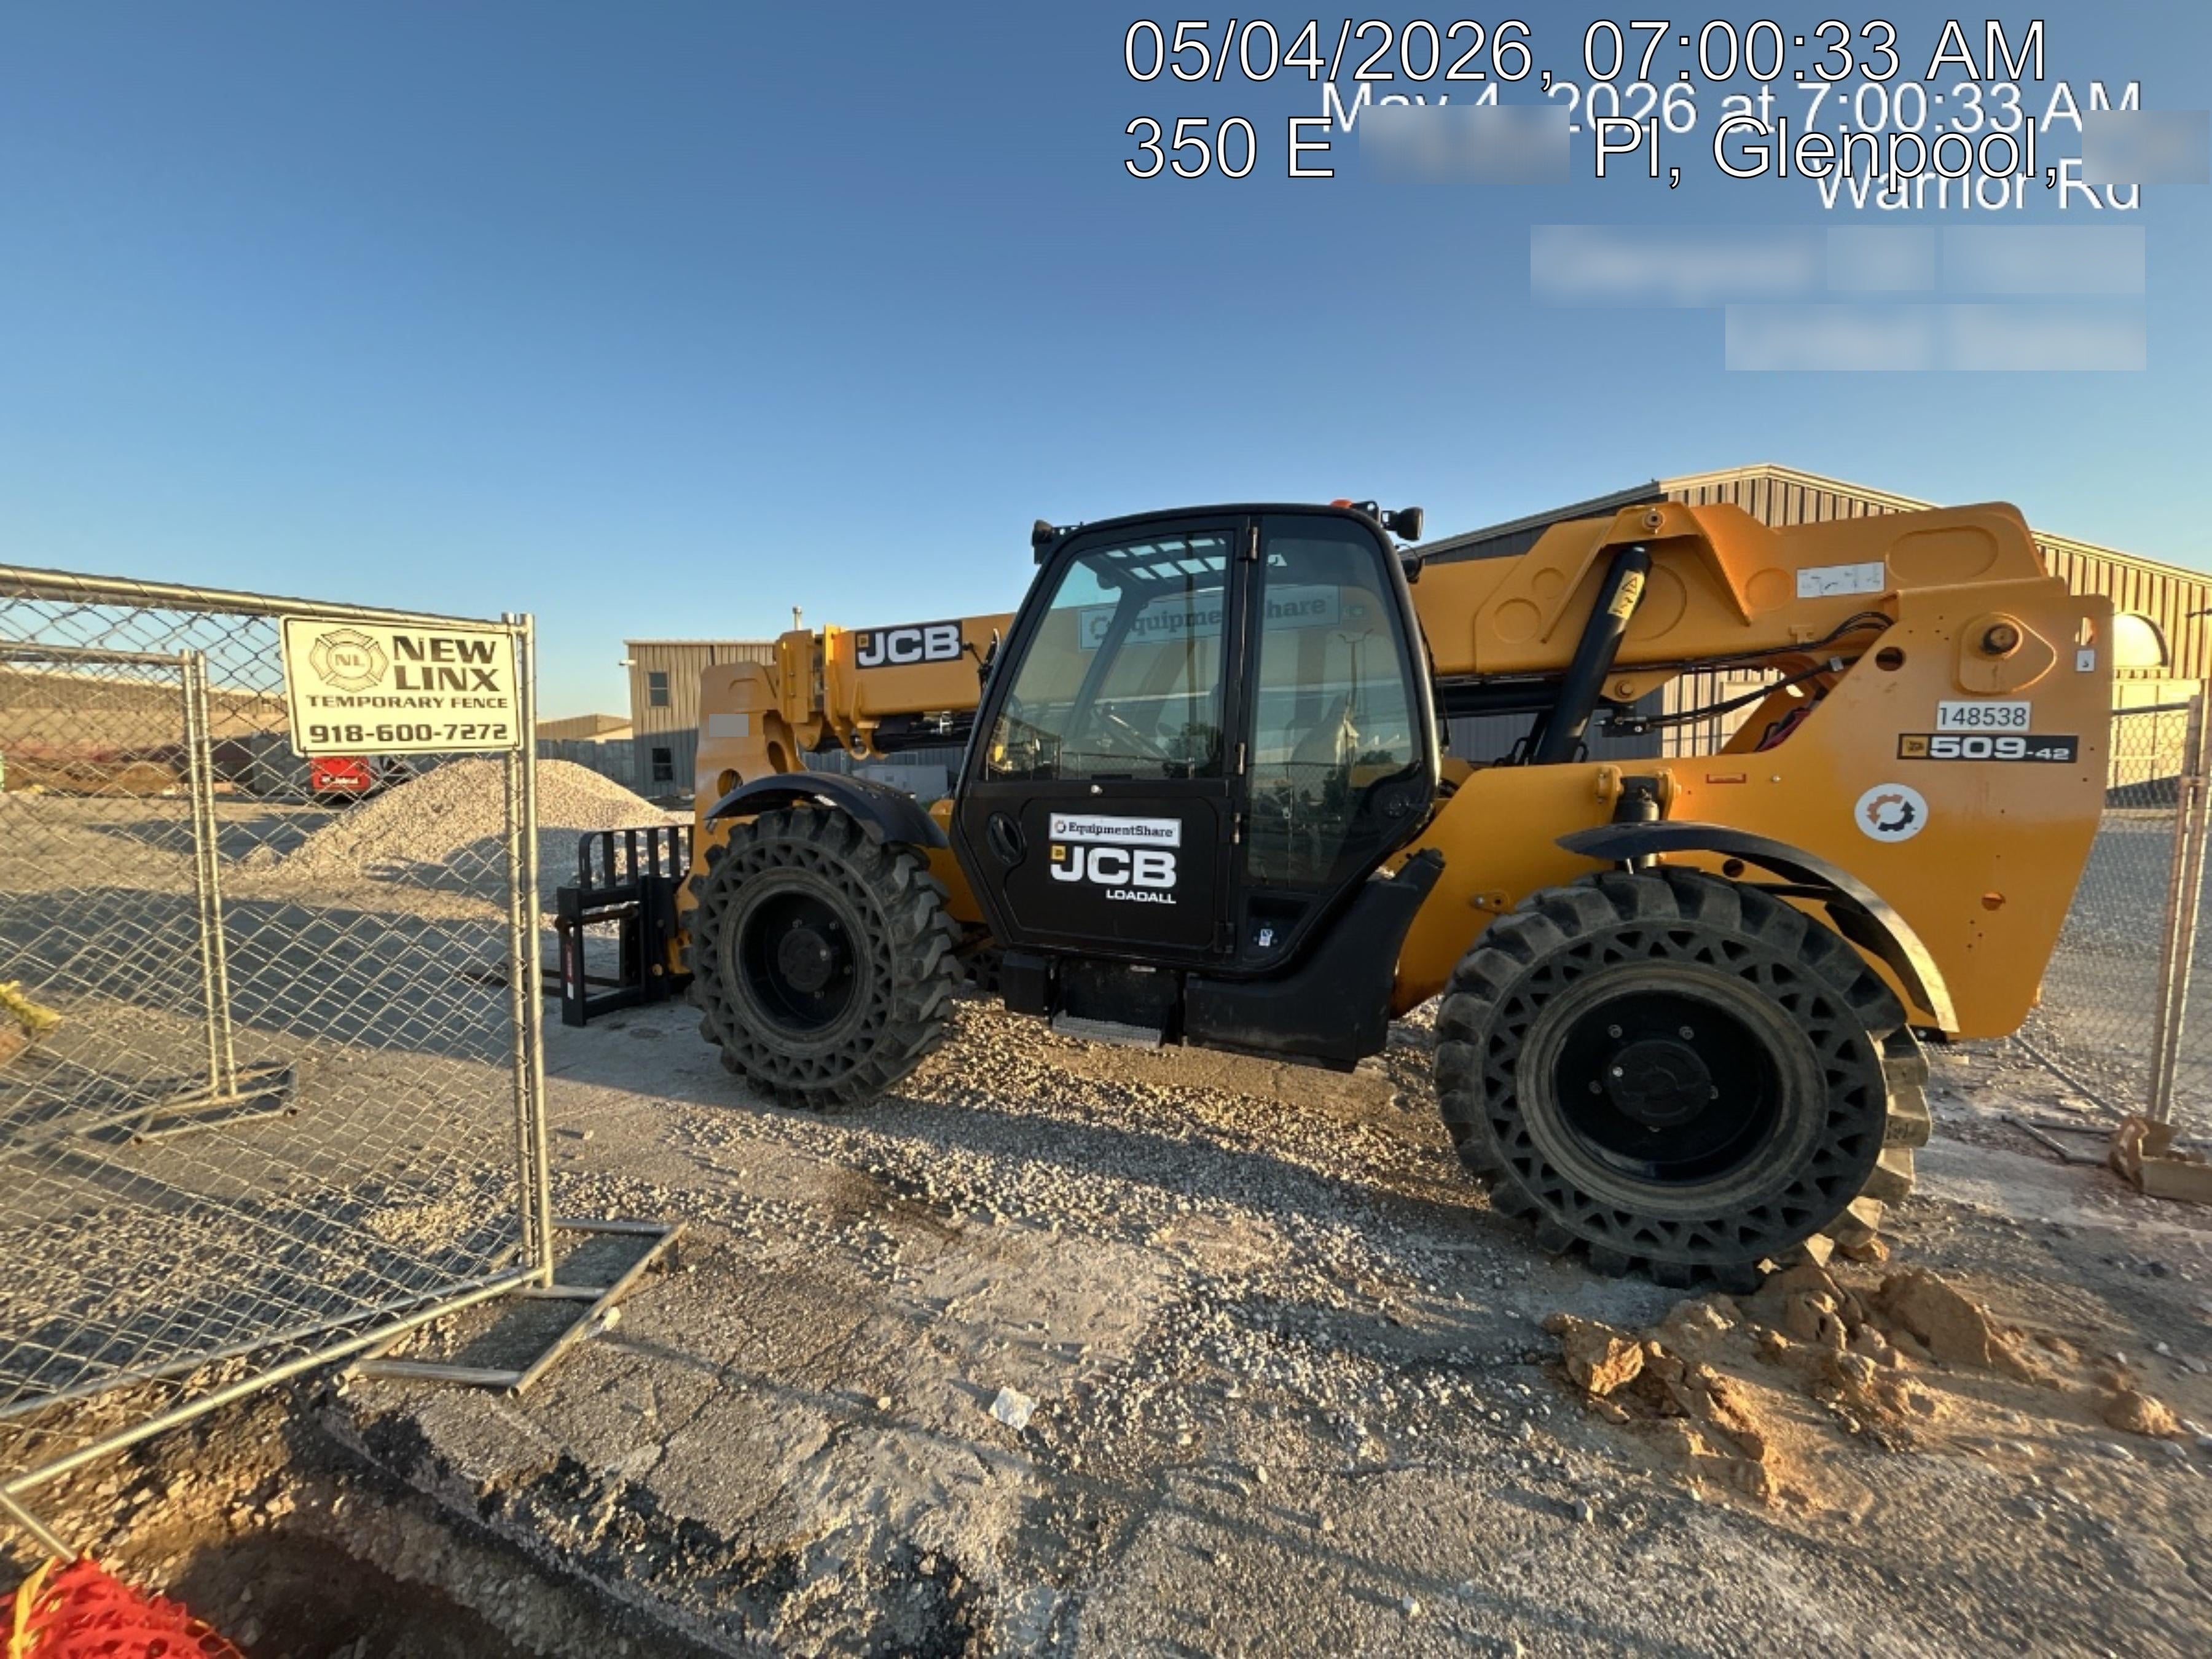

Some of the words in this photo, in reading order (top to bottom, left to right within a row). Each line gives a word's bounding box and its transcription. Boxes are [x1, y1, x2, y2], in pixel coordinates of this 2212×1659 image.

[393, 635, 496, 664] NEW
[858, 625, 959, 666] JCB
[335, 654, 365, 667] NL
[396, 665, 500, 692] LINX
[307, 695, 444, 708] TEMPORARY
[451, 697, 508, 708] FENCE
[1939, 707, 2026, 726] 148538
[310, 724, 508, 743] 918-600-7272
[1929, 737, 2070, 760] 509-42
[1069, 822, 1173, 837] EquipmentShare
[1050, 845, 1177, 888] JCB
[1105, 889, 1177, 904] LOADALL
